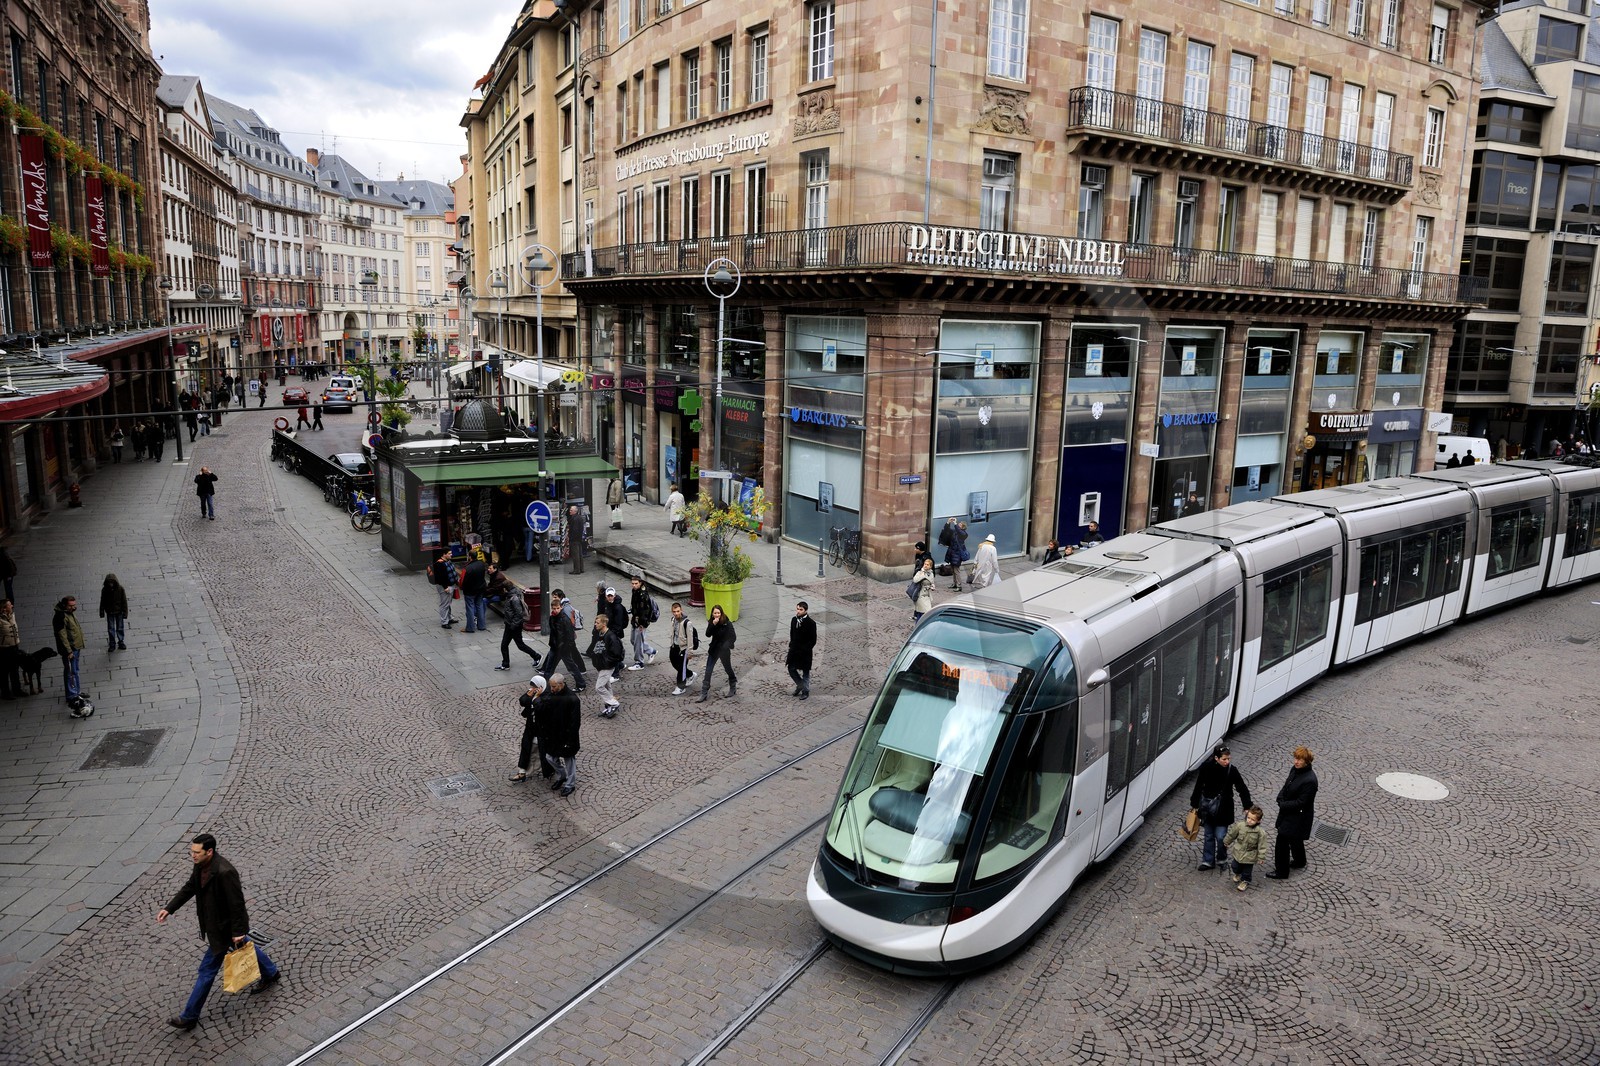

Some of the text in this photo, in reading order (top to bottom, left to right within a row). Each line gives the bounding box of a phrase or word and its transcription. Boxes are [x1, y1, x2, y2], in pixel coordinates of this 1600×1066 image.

[643, 154, 668, 172] Presse
[670, 131, 769, 167] Strasbourg-Europe
[1507, 182, 1528, 195] fnac
[909, 225, 1126, 265] DETECTIVE NIBEL
[907, 252, 976, 268] RECHERCHES
[1049, 263, 1122, 276] SURVEILLANCES
[1487, 350, 1507, 360] fnac
[721, 396, 756, 412] PHARMACIE
[725, 409, 749, 422] KLEBER
[801, 409, 847, 428] BARCLAYS
[1174, 412, 1217, 426] BARCLAYS
[1320, 413, 1360, 428] COIFFURE
[1430, 416, 1449, 429] COURIR
